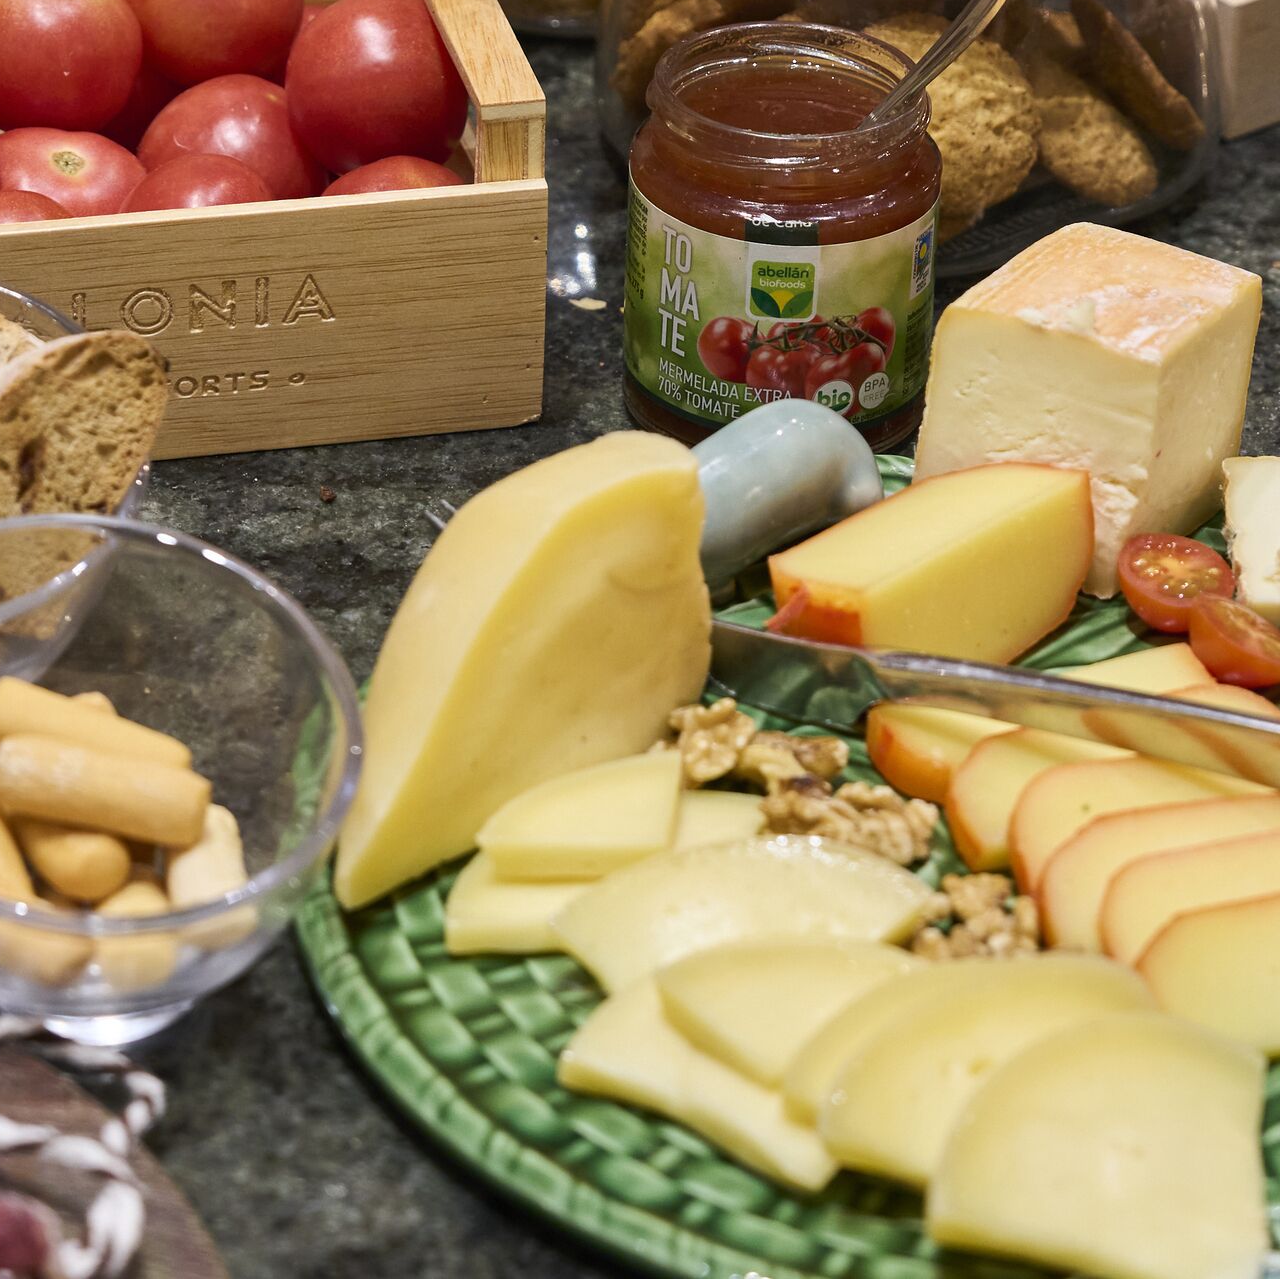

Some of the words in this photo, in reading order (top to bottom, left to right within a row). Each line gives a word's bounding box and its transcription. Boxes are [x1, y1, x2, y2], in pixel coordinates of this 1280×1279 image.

[662, 224, 692, 274] TO
[660, 266, 700, 321] MA
[757, 265, 809, 279] abellán
[760, 278, 806, 289] biofoods
[72, 273, 336, 337] LONIA
[658, 306, 687, 357] TE
[172, 370, 270, 399] ORTS
[658, 375, 681, 401] 70%
[685, 390, 741, 419] TOMATE
[659, 357, 740, 400] MERMELADA
[744, 387, 793, 404] EXTRA
[817, 389, 851, 408] bio
[864, 378, 887, 392] BPA
